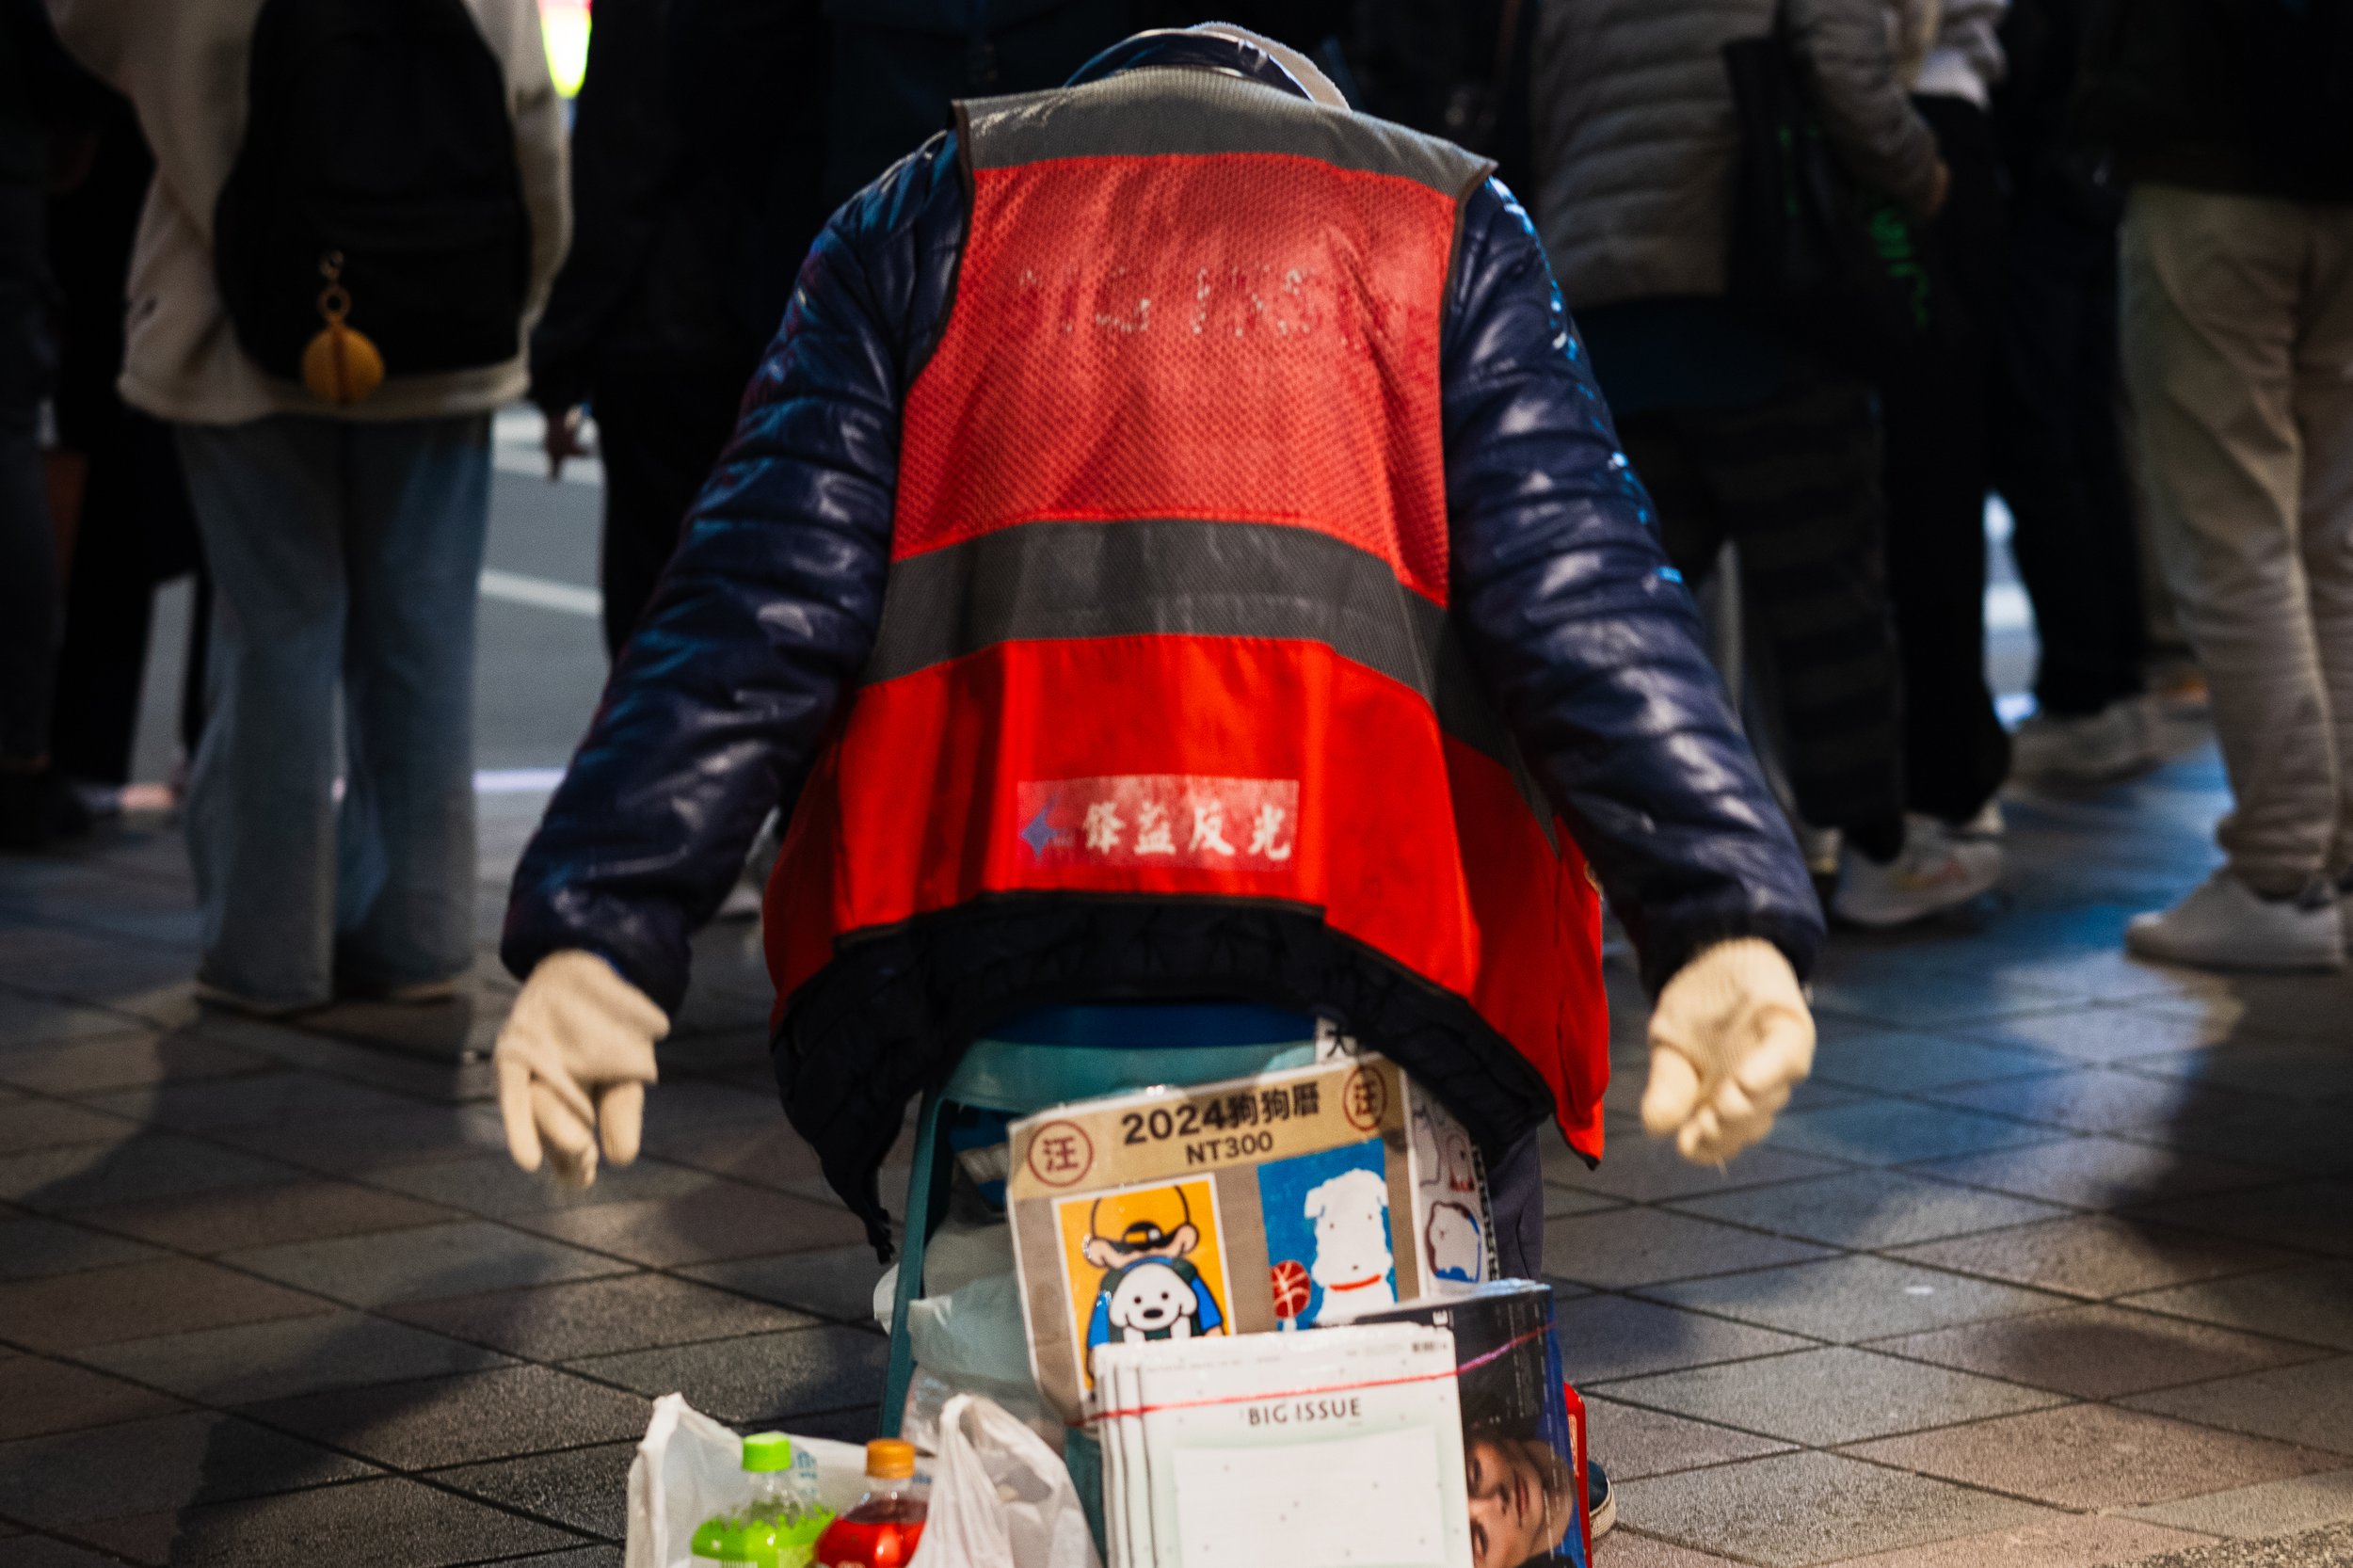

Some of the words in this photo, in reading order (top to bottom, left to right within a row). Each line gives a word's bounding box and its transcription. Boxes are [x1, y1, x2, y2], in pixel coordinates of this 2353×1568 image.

[1185, 1130, 1273, 1165] NT300
[1249, 1405, 1288, 1426] BIG
[1296, 1397, 1361, 1421] ISSUE
